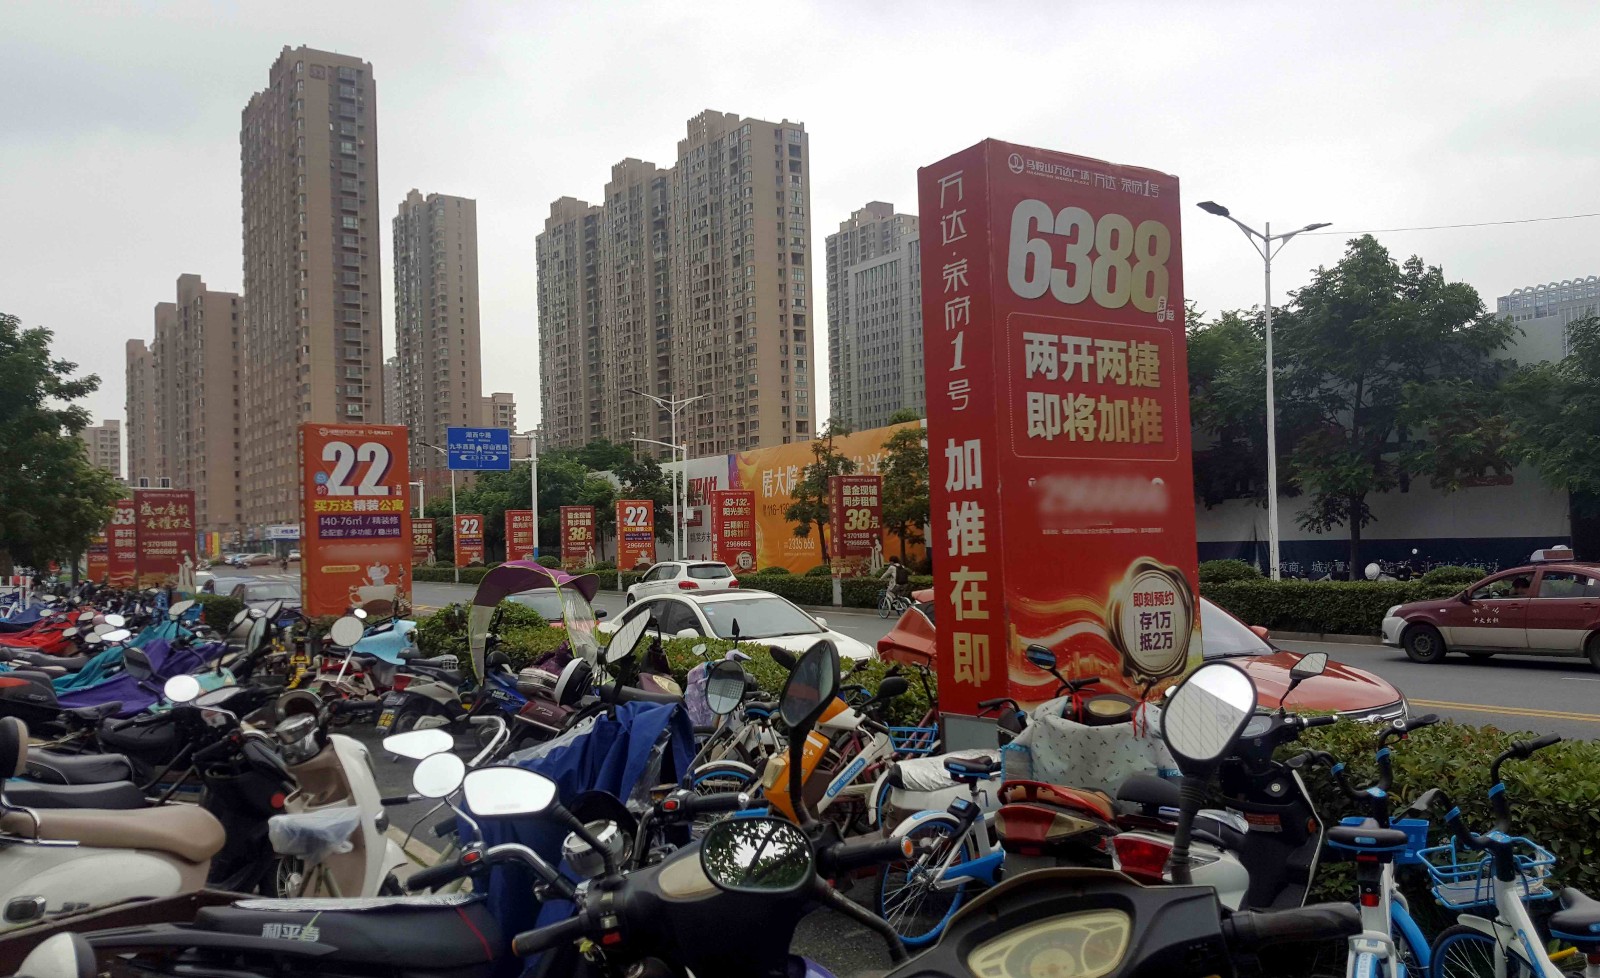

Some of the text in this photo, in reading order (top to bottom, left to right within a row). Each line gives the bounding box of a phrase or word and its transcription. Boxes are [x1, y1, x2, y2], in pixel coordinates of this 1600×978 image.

[1026, 159, 1090, 181] 马鞍山万达广场
[1007, 199, 1171, 313] 6388
[1023, 331, 1161, 388] 两开两捷
[1026, 391, 1164, 444] 即将加推
[322, 441, 389, 496] 22
[314, 499, 404, 511] 买万达精装公寓
[842, 496, 878, 507] 同步租售
[461, 518, 479, 534] 22
[625, 506, 648, 526] 22
[844, 508, 871, 531] 38
[413, 534, 429, 546] 38
[568, 526, 586, 541] 38
[945, 438, 990, 688] 加推在即
[1133, 590, 1175, 607] 即刻预约
[1139, 610, 1171, 630] 存1万
[1139, 631, 1173, 651] 抵2万
